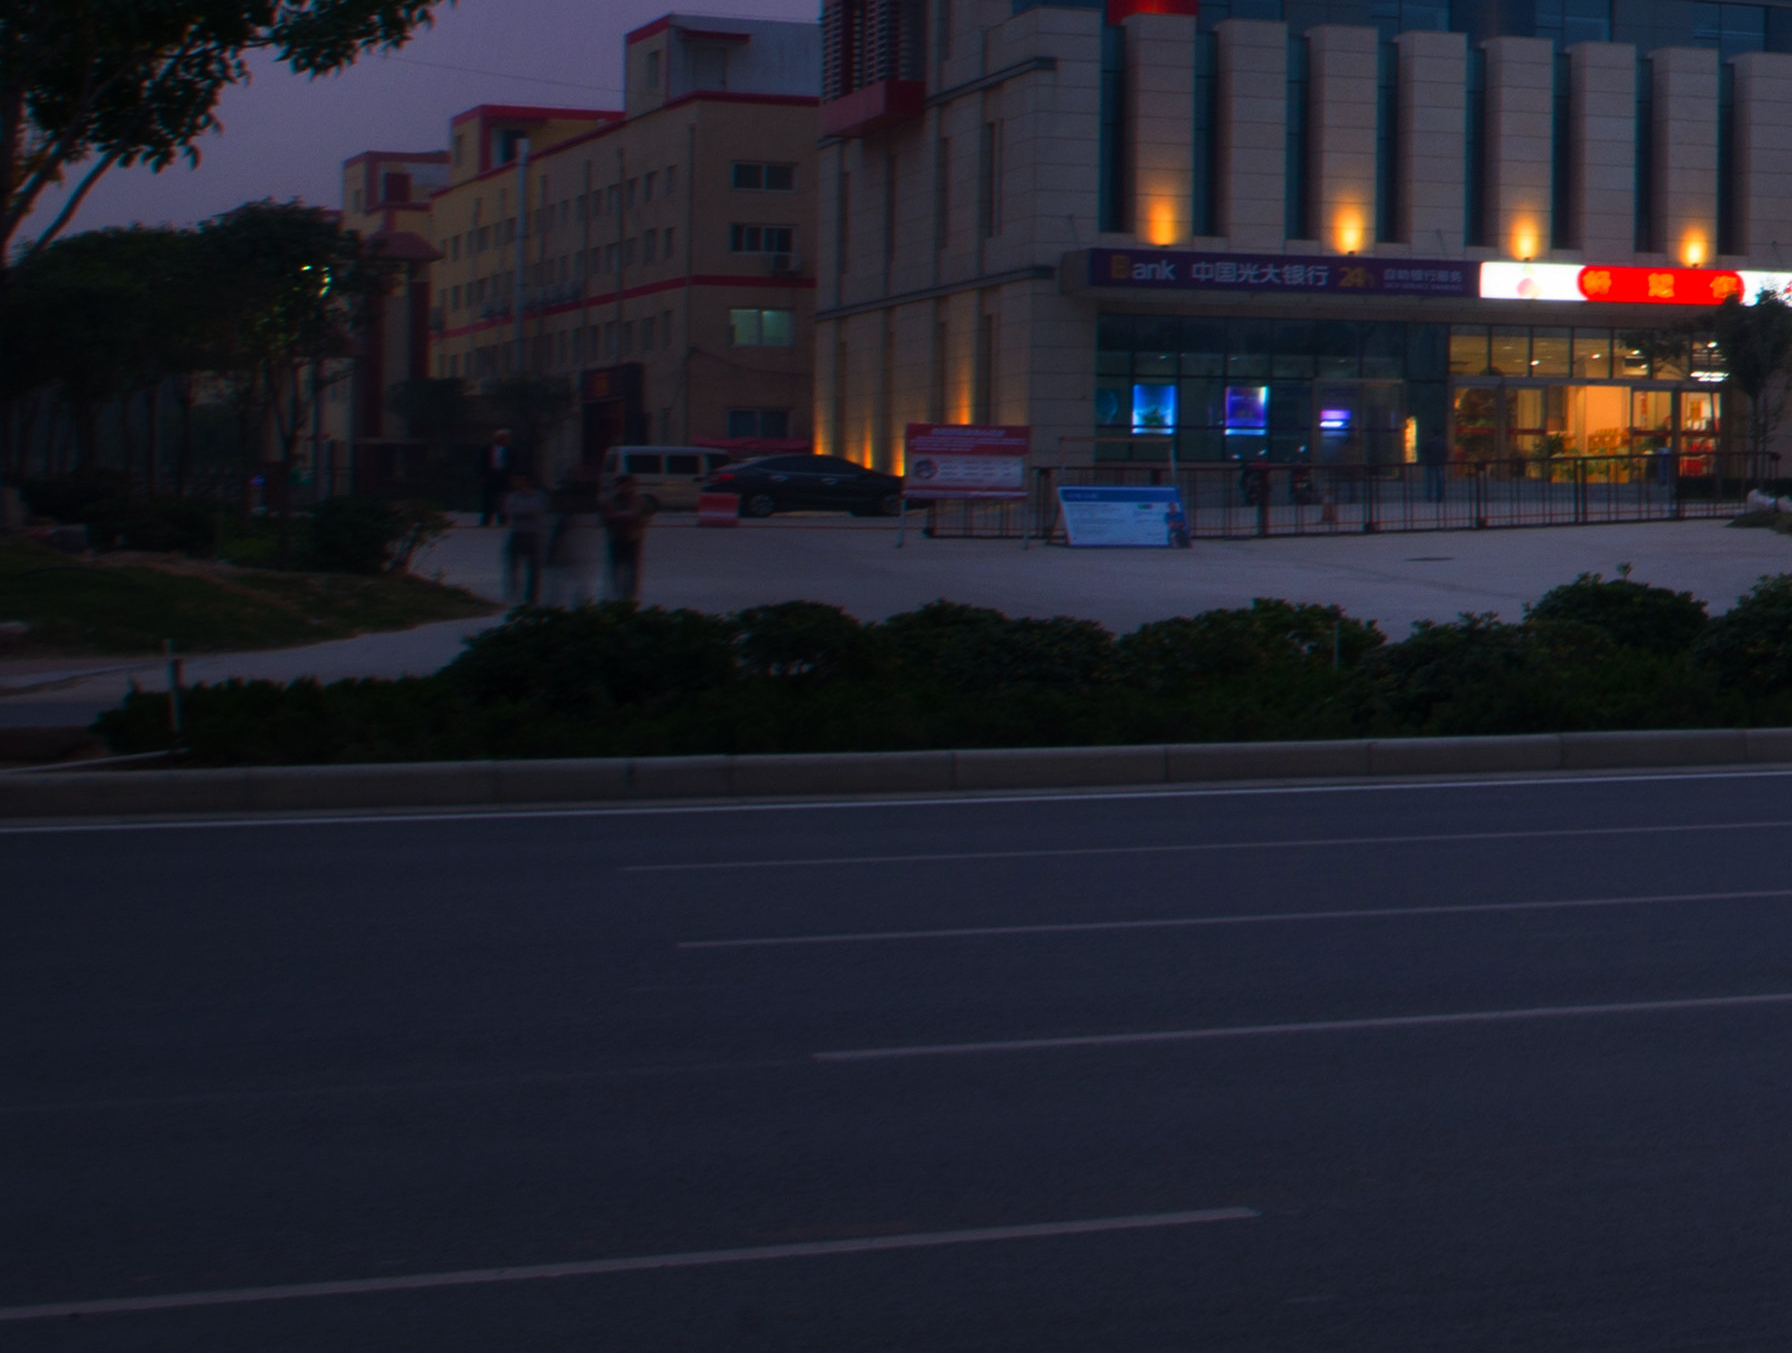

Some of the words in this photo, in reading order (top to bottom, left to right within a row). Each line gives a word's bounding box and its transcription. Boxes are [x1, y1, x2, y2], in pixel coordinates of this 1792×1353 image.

[1111, 254, 1176, 281] Bank
[1192, 260, 1330, 286] 中国光大银行
